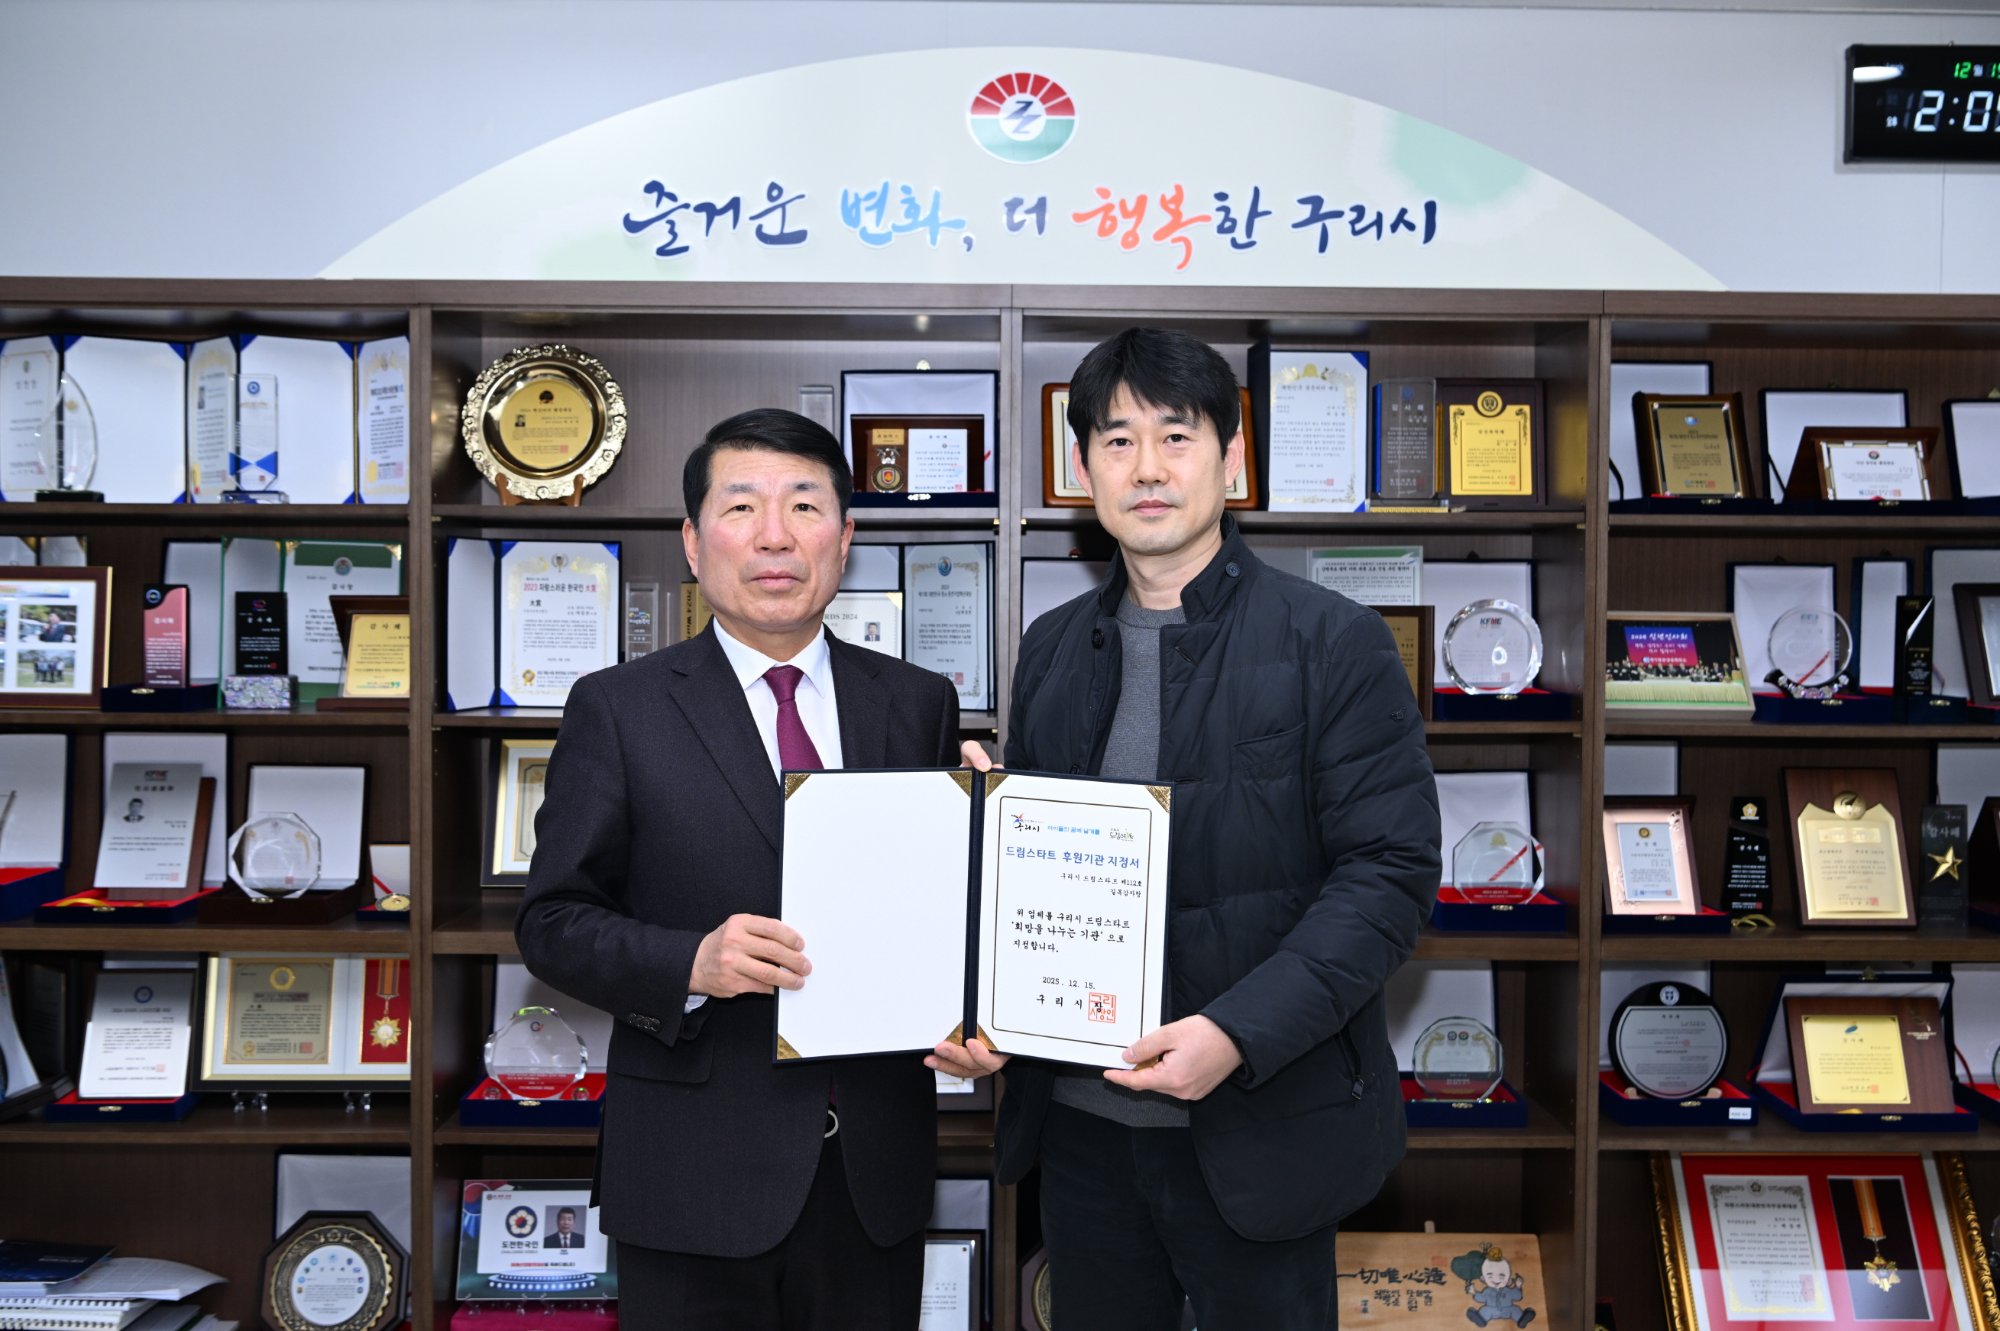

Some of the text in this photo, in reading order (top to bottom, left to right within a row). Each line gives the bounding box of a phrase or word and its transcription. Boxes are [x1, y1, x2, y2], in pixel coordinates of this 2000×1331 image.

[1954, 62, 1971, 78] 12
[623, 180, 1437, 270] 즐거운 변화, 더 행복한 구리시
[524, 583, 538, 592] 2023
[539, 583, 566, 592] 자랑스러운
[568, 584, 584, 592] 한국인
[1006, 846, 1140, 869] 드림스타트 후원기관 지정서
[1060, 872, 1080, 881] 구리시
[1083, 876, 1118, 885] 드림스타트
[1017, 908, 1130, 929] 위 업체를 구리시 드림스타트
[1047, 925, 1076, 939] 나누는
[1107, 934, 1125, 943] 으로
[1013, 939, 1059, 953] 지정합니다.
[502, 1240, 538, 1249] 도전한국인
